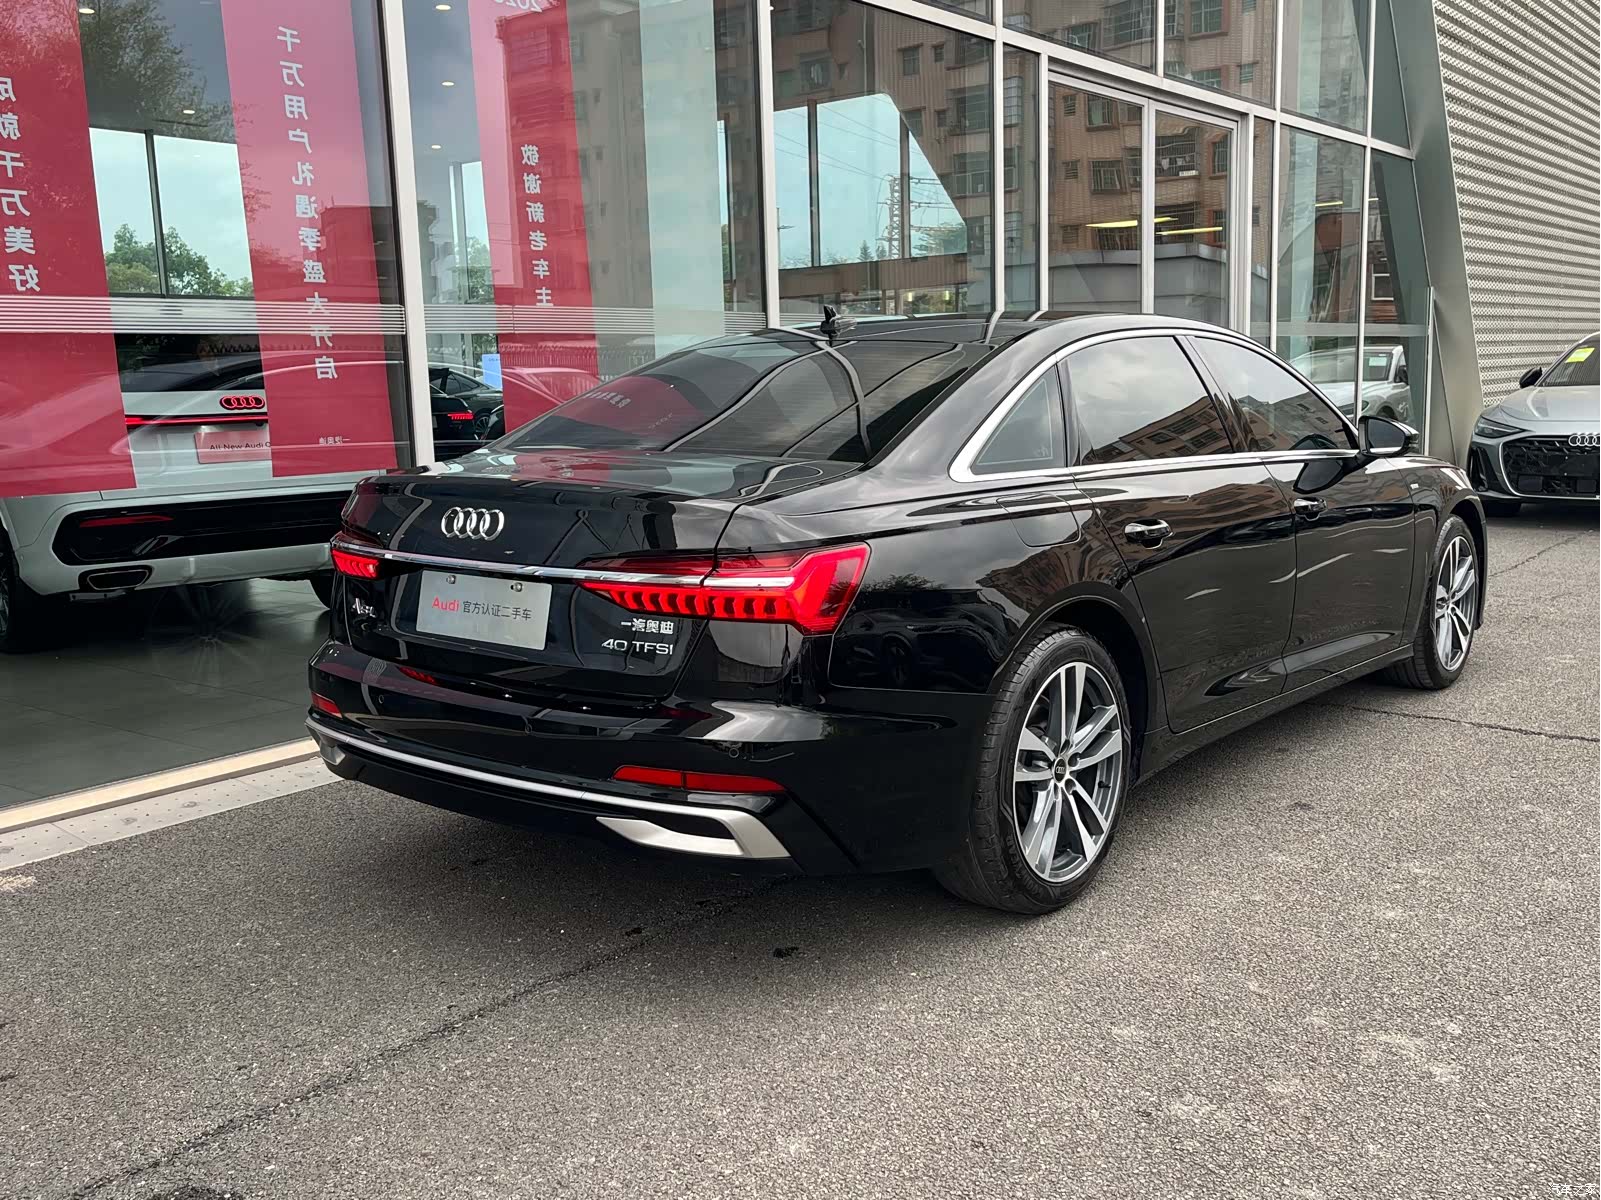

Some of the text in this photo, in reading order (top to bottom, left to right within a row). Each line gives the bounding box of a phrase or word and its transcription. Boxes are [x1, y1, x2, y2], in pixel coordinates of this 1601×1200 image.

[432, 596, 532, 621] Audi 官方认证二手车
[621, 618, 674, 635] 一汽奥迪
[602, 638, 673, 655] 40 TFSI
